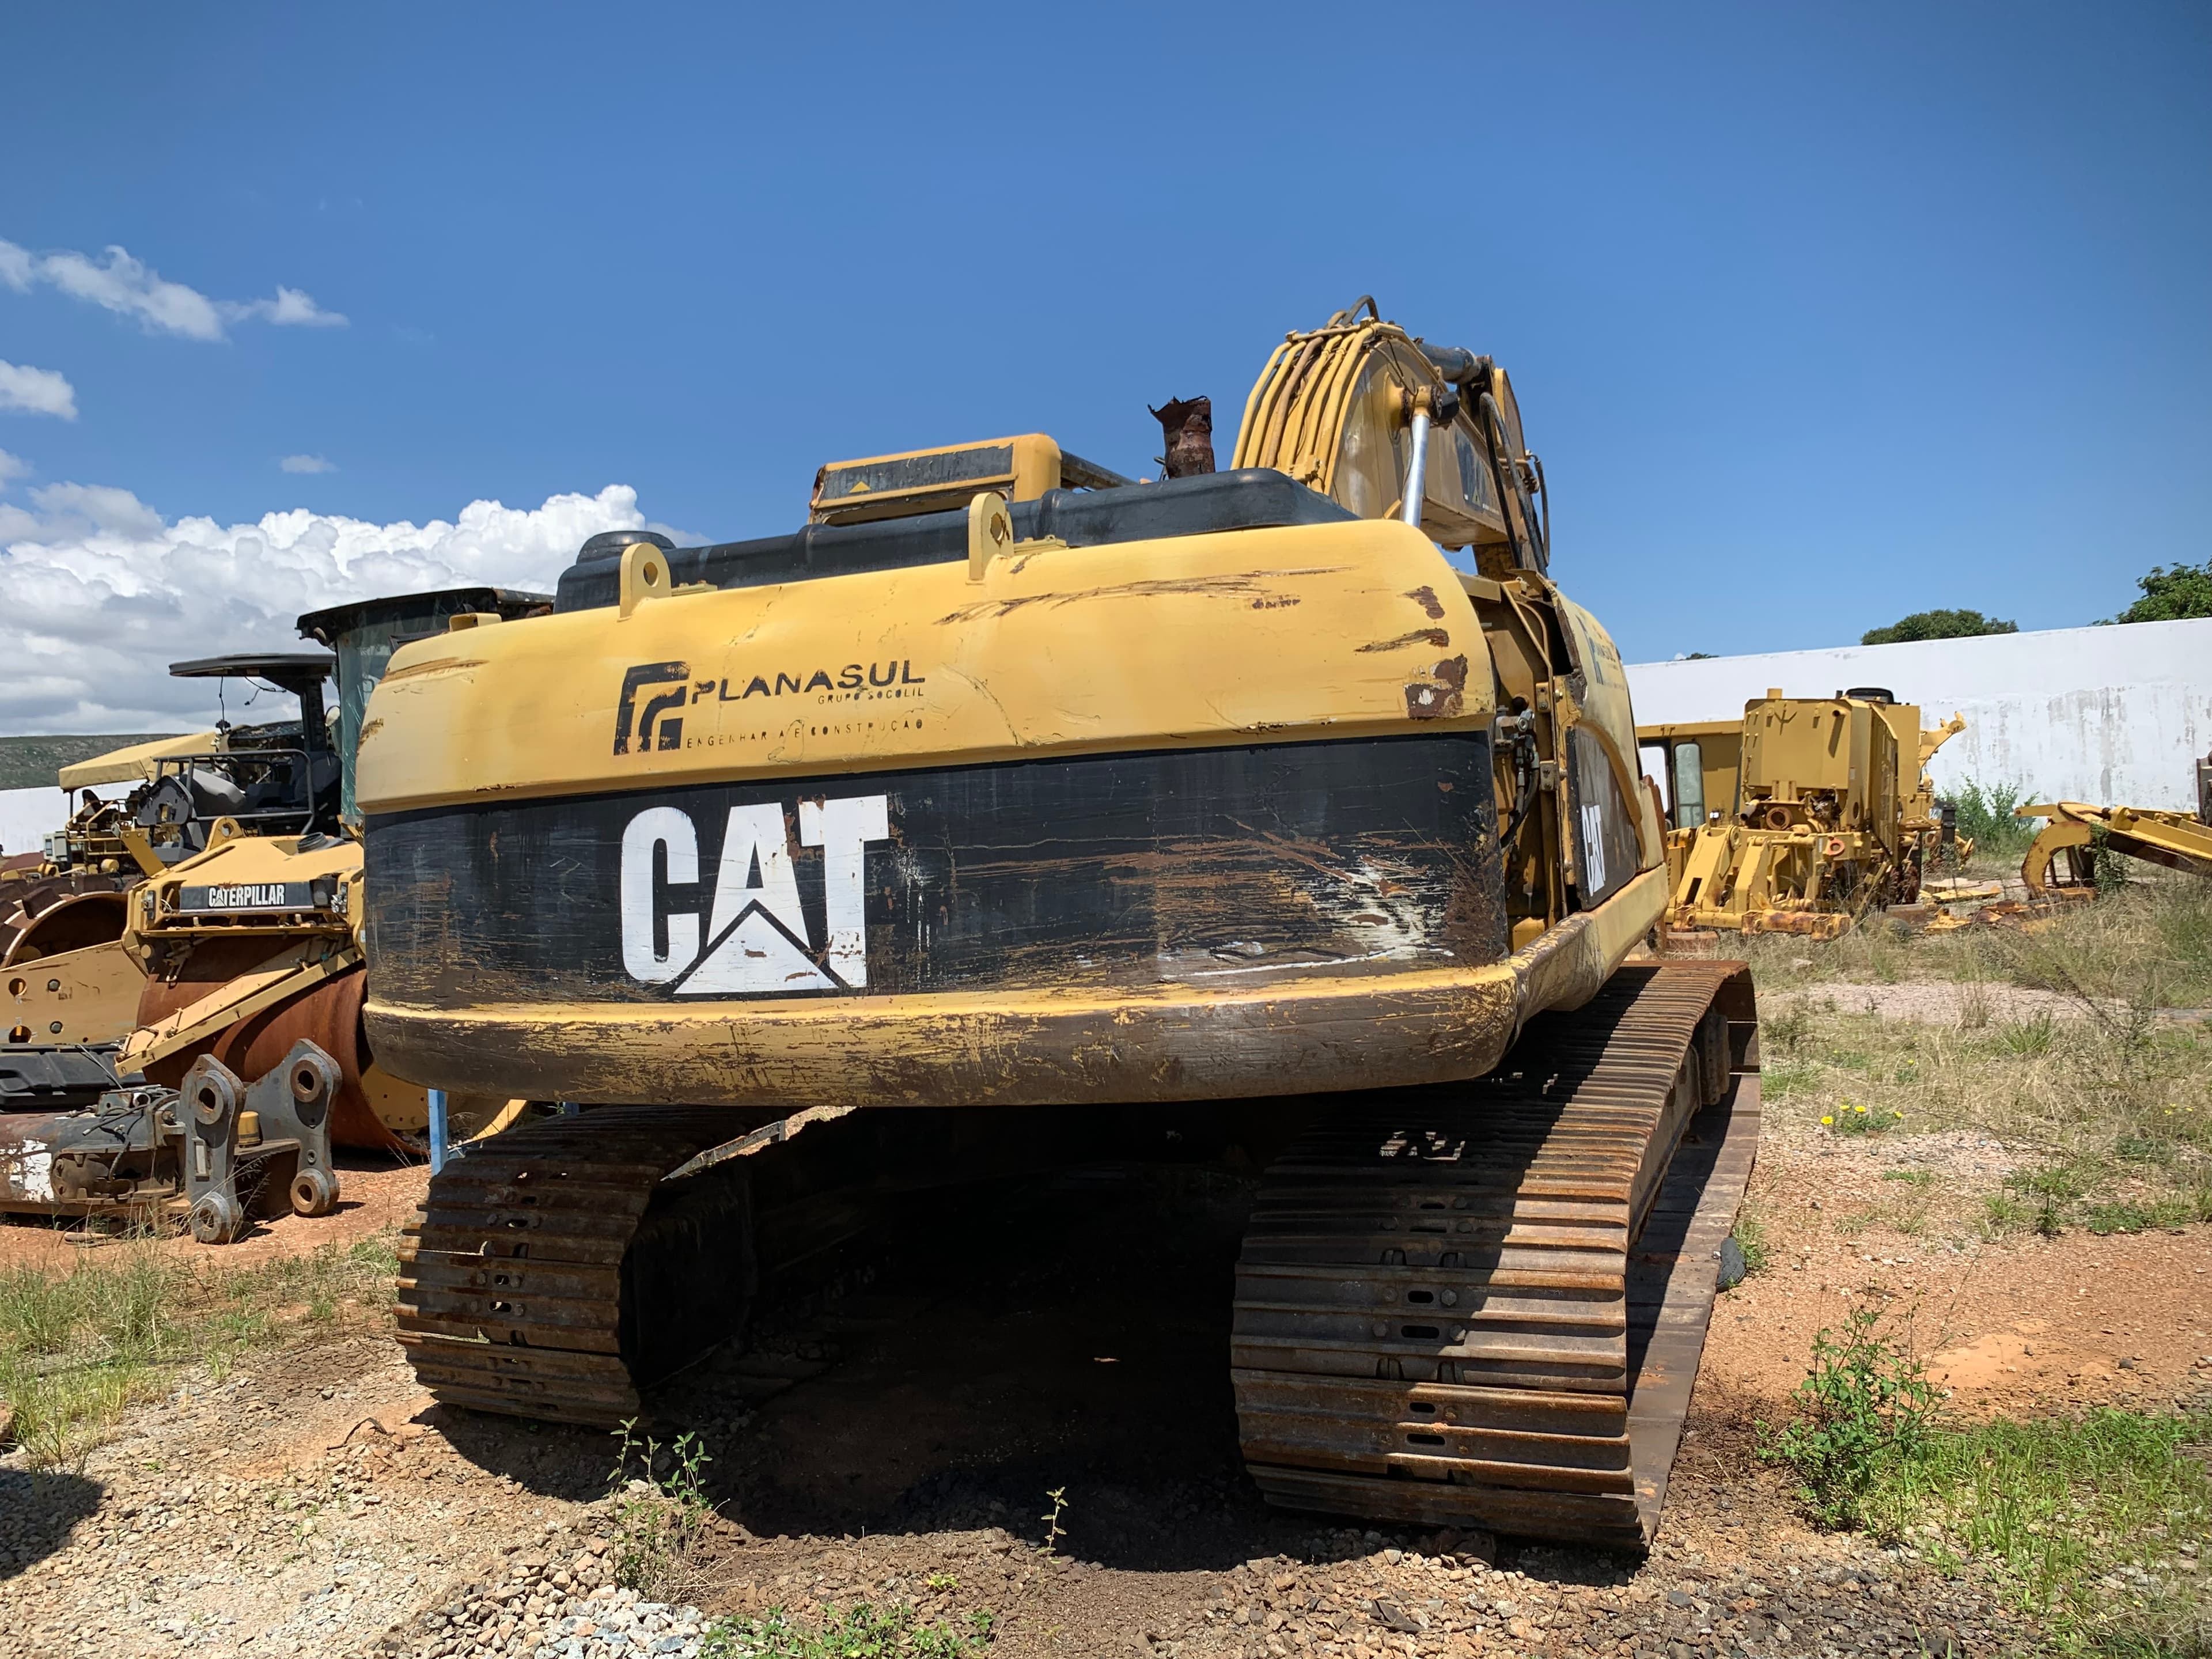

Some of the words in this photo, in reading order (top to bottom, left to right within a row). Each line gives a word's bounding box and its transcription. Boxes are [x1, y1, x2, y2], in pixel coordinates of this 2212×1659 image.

[691, 660, 925, 704] PLANASUL
[818, 692, 859, 705] GRUPO
[1581, 805, 1606, 897] CAT
[208, 884, 285, 908] CATERPILLAR
[620, 794, 889, 994] CAT
